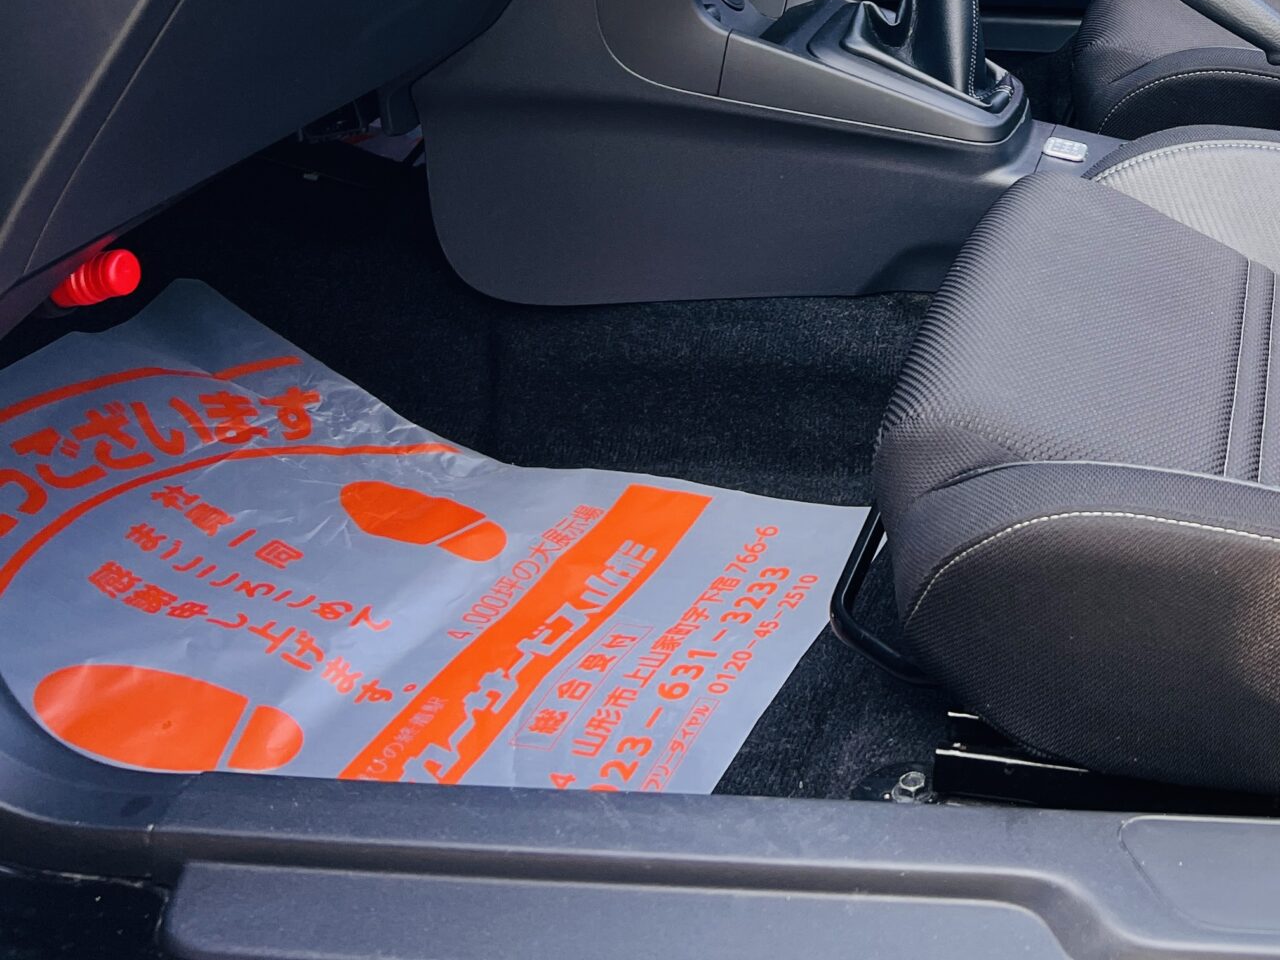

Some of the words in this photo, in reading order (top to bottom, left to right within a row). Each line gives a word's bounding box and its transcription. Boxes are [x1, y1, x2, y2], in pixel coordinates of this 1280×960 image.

[127, 524, 391, 630] まごころこめて
[152, 486, 304, 568] 社員一同
[449, 504, 608, 640] 4,000坪の大展示場
[591, 567, 791, 792] 23-631-3233
[708, 575, 819, 695] 0120-45-2510
